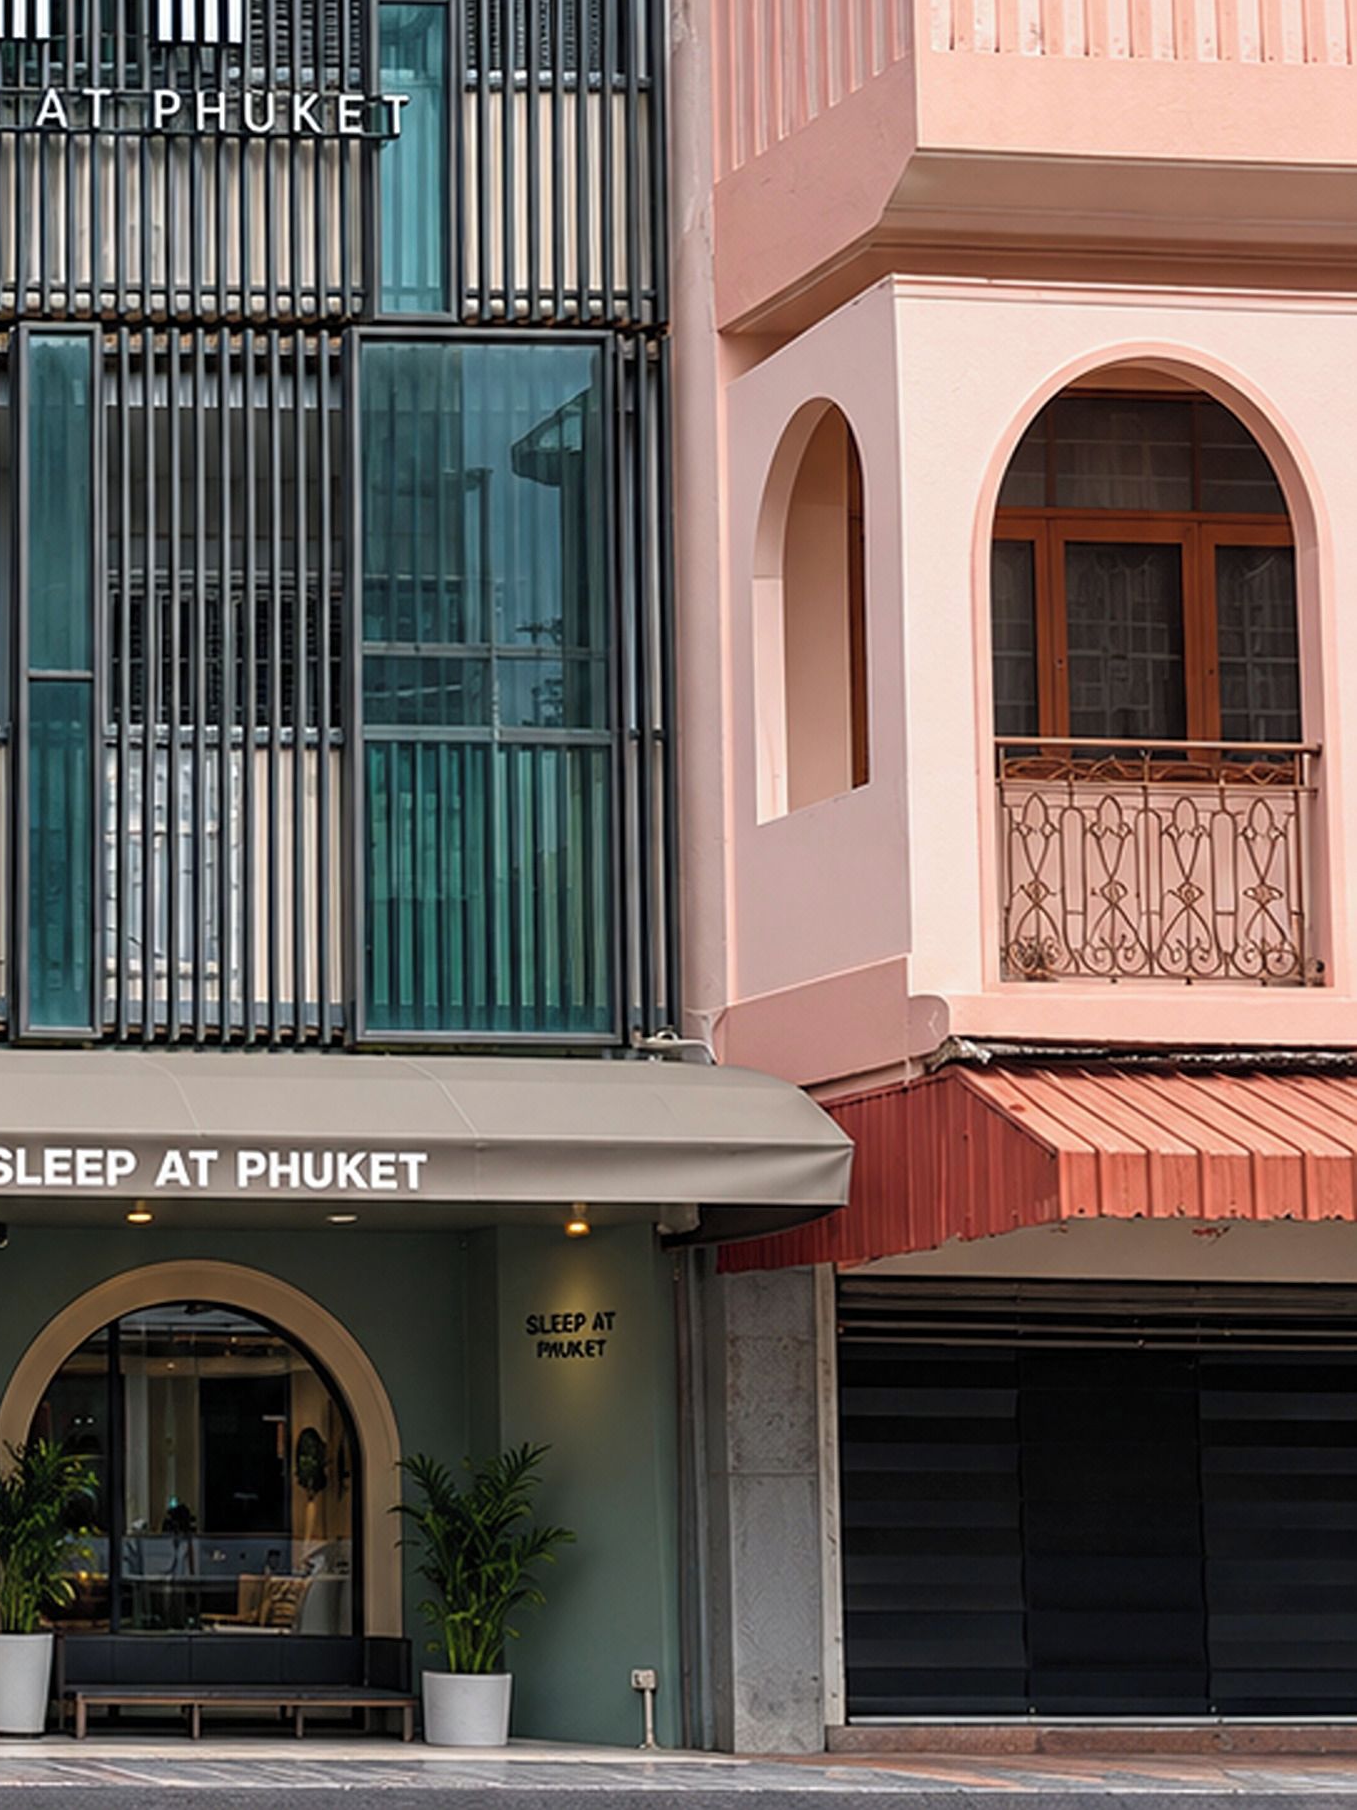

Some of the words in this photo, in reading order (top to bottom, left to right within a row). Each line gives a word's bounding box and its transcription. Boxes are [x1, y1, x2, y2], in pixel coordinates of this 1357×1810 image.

[35, 88, 112, 128] AT
[154, 90, 411, 135] PHUKET
[155, 1149, 218, 1188] AT
[237, 1151, 428, 1190] PHUKET
[525, 1312, 587, 1335] SLEEP
[592, 1311, 616, 1331] AT
[536, 1339, 606, 1358] PHUKET
